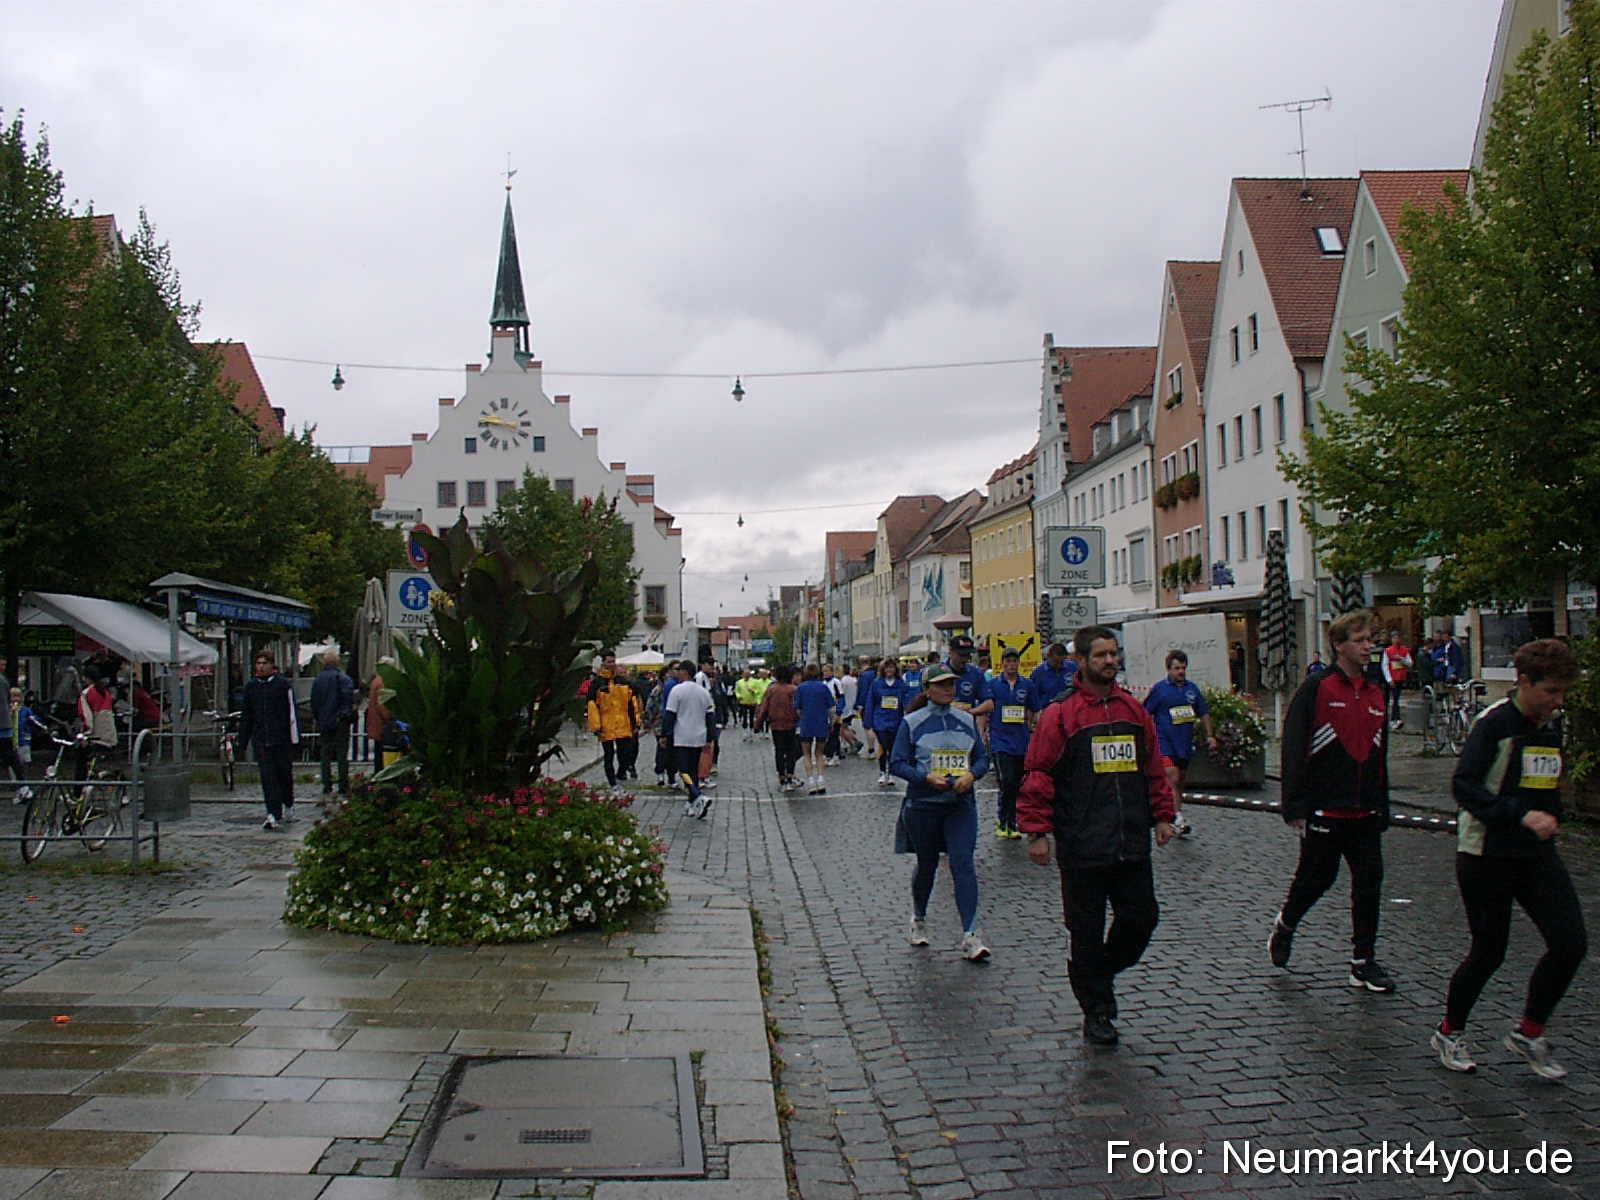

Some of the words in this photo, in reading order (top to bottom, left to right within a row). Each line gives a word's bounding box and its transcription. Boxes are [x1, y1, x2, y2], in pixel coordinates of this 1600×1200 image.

[1061, 570, 1089, 580] ZONE
[400, 613, 430, 624] ZONE
[1101, 743, 1132, 761] 1040
[938, 755, 965, 769] 1132
